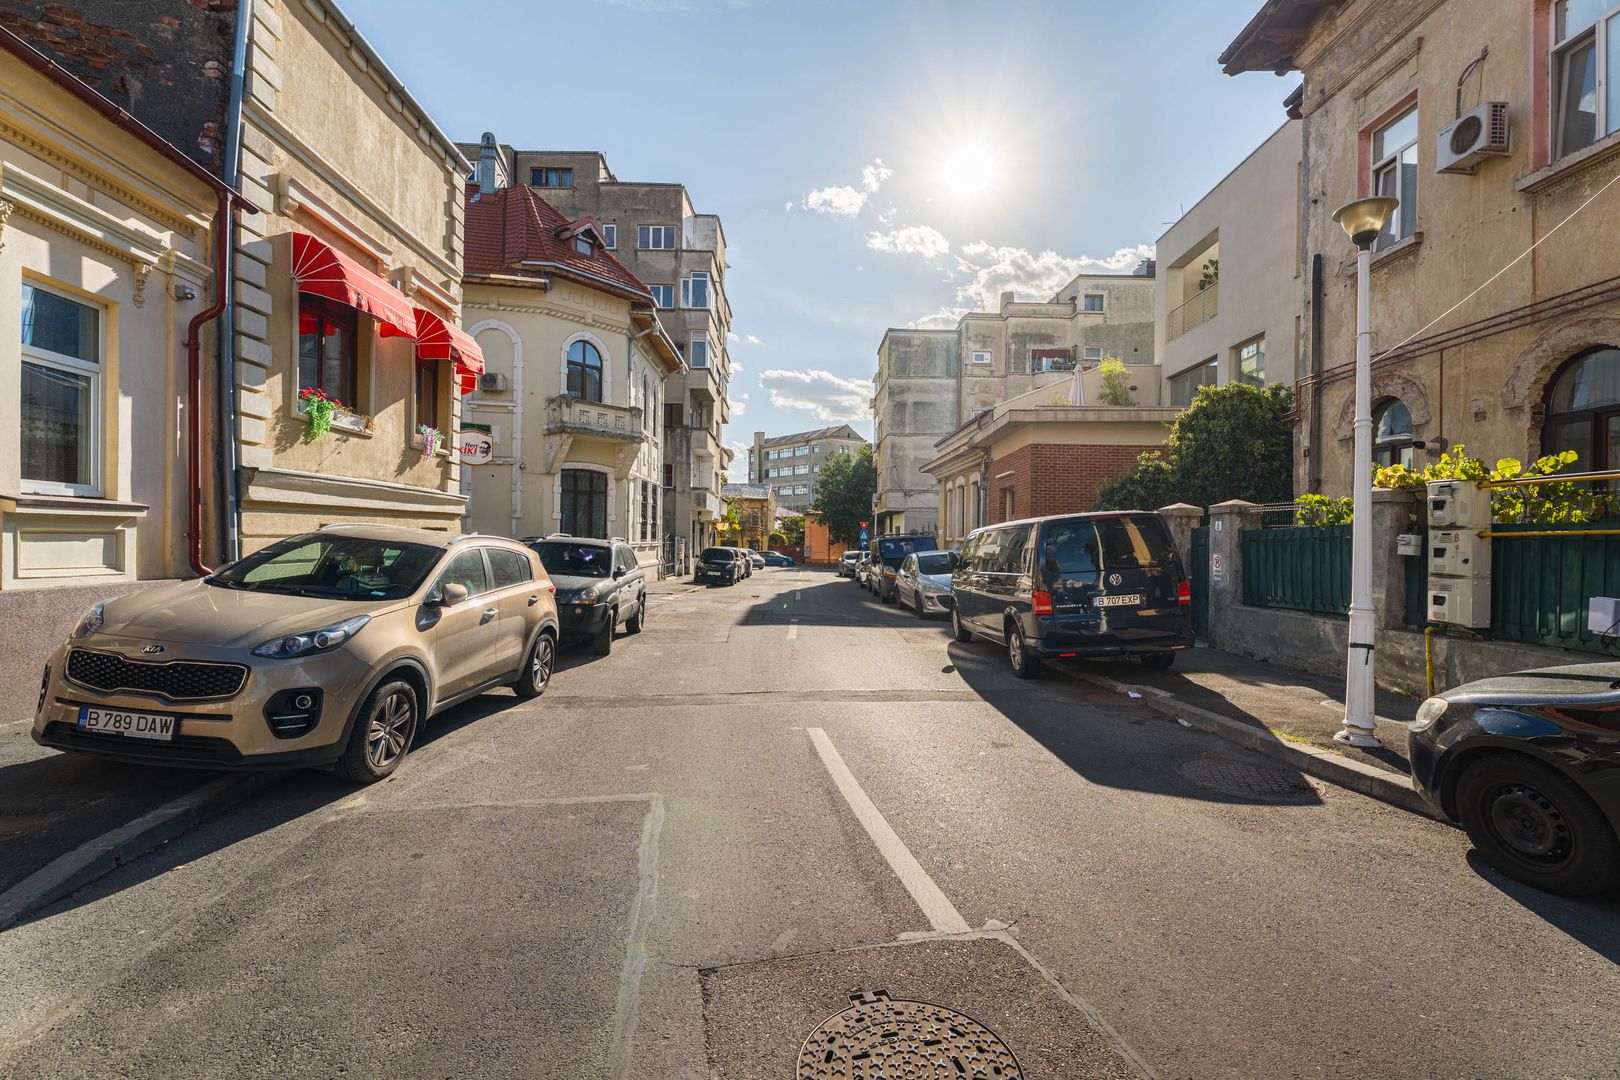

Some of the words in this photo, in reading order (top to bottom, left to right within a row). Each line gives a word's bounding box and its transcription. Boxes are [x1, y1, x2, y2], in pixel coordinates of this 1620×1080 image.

[1098, 597, 1105, 606] B
[1106, 597, 1120, 605] 707
[1121, 595, 1139, 604] EXP
[88, 711, 100, 727] B
[103, 713, 133, 730] 789
[136, 716, 173, 735] DAW
